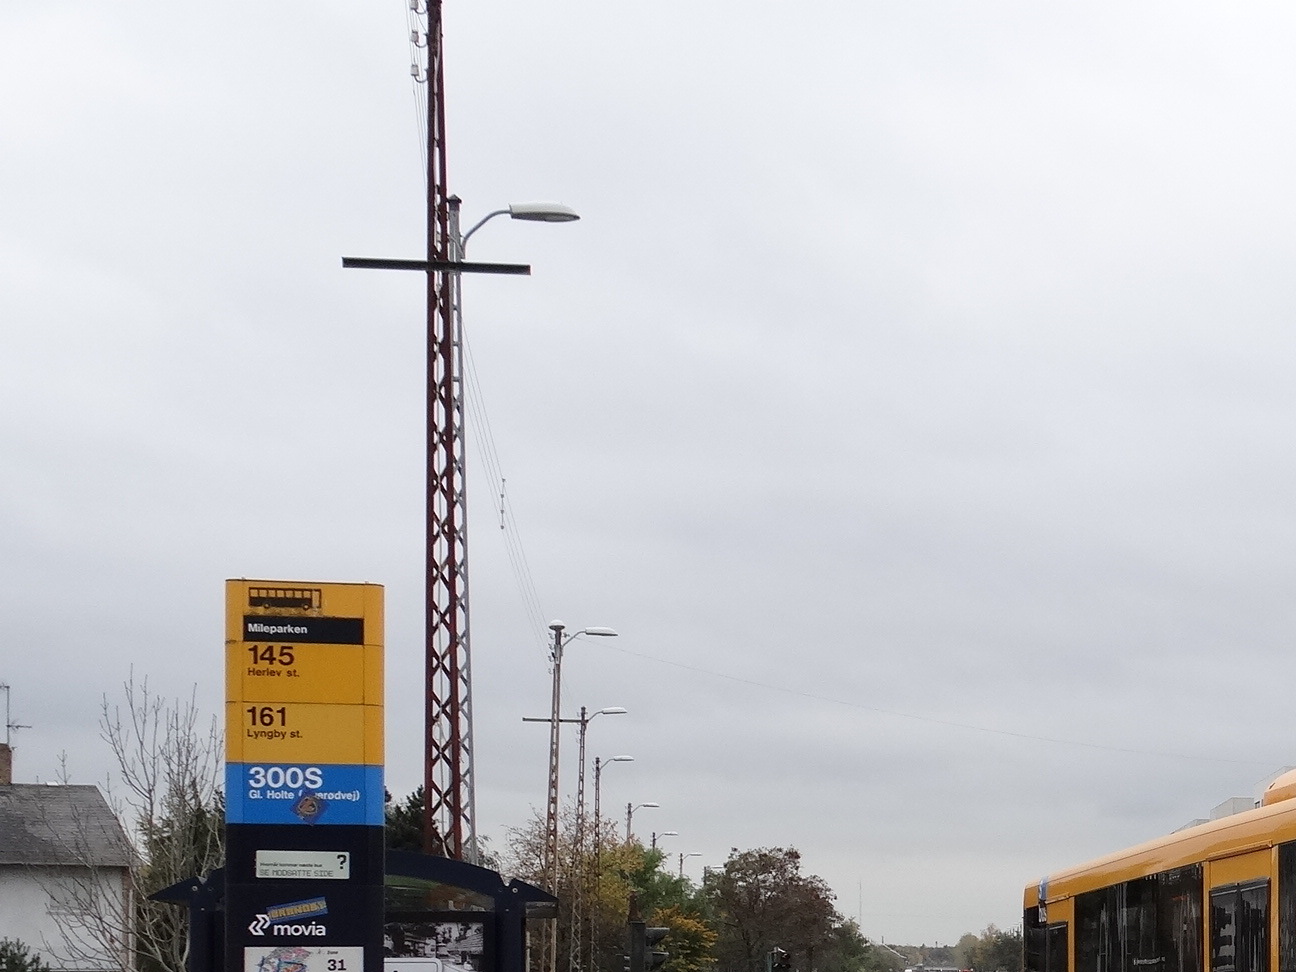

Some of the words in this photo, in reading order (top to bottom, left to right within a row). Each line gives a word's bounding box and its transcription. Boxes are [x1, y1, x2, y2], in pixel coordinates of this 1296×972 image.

[247, 622, 308, 636] Mileparken
[248, 645, 294, 666] 145
[247, 668, 282, 678] Herlev
[286, 668, 300, 678] st.
[247, 706, 286, 727] 161
[247, 729, 286, 740] Lyngby
[289, 730, 303, 739] st.
[248, 766, 323, 789] 300S
[266, 790, 294, 799] Holte
[273, 921, 326, 937] movia
[327, 958, 347, 972] 31
